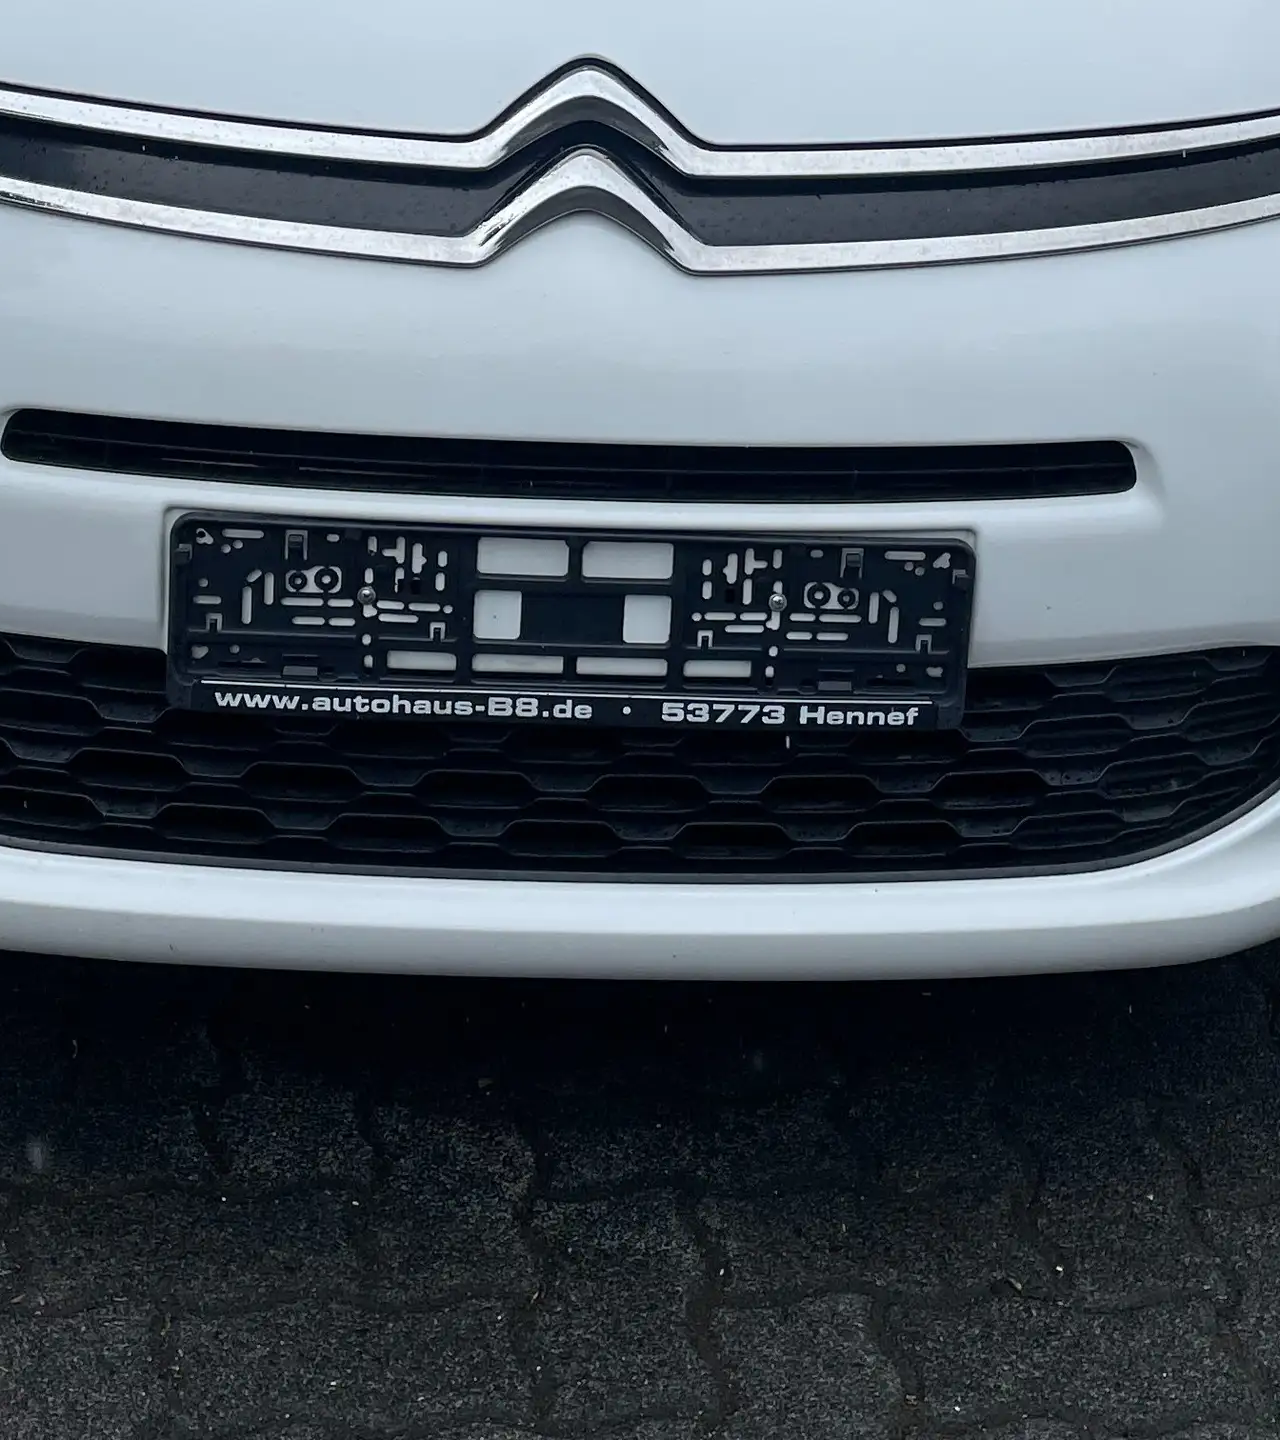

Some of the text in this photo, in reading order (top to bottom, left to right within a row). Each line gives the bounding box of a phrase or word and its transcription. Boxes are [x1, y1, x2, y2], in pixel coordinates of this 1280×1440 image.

[214, 691, 919, 726] www.autohaus-B8.de 53773 Hennef
